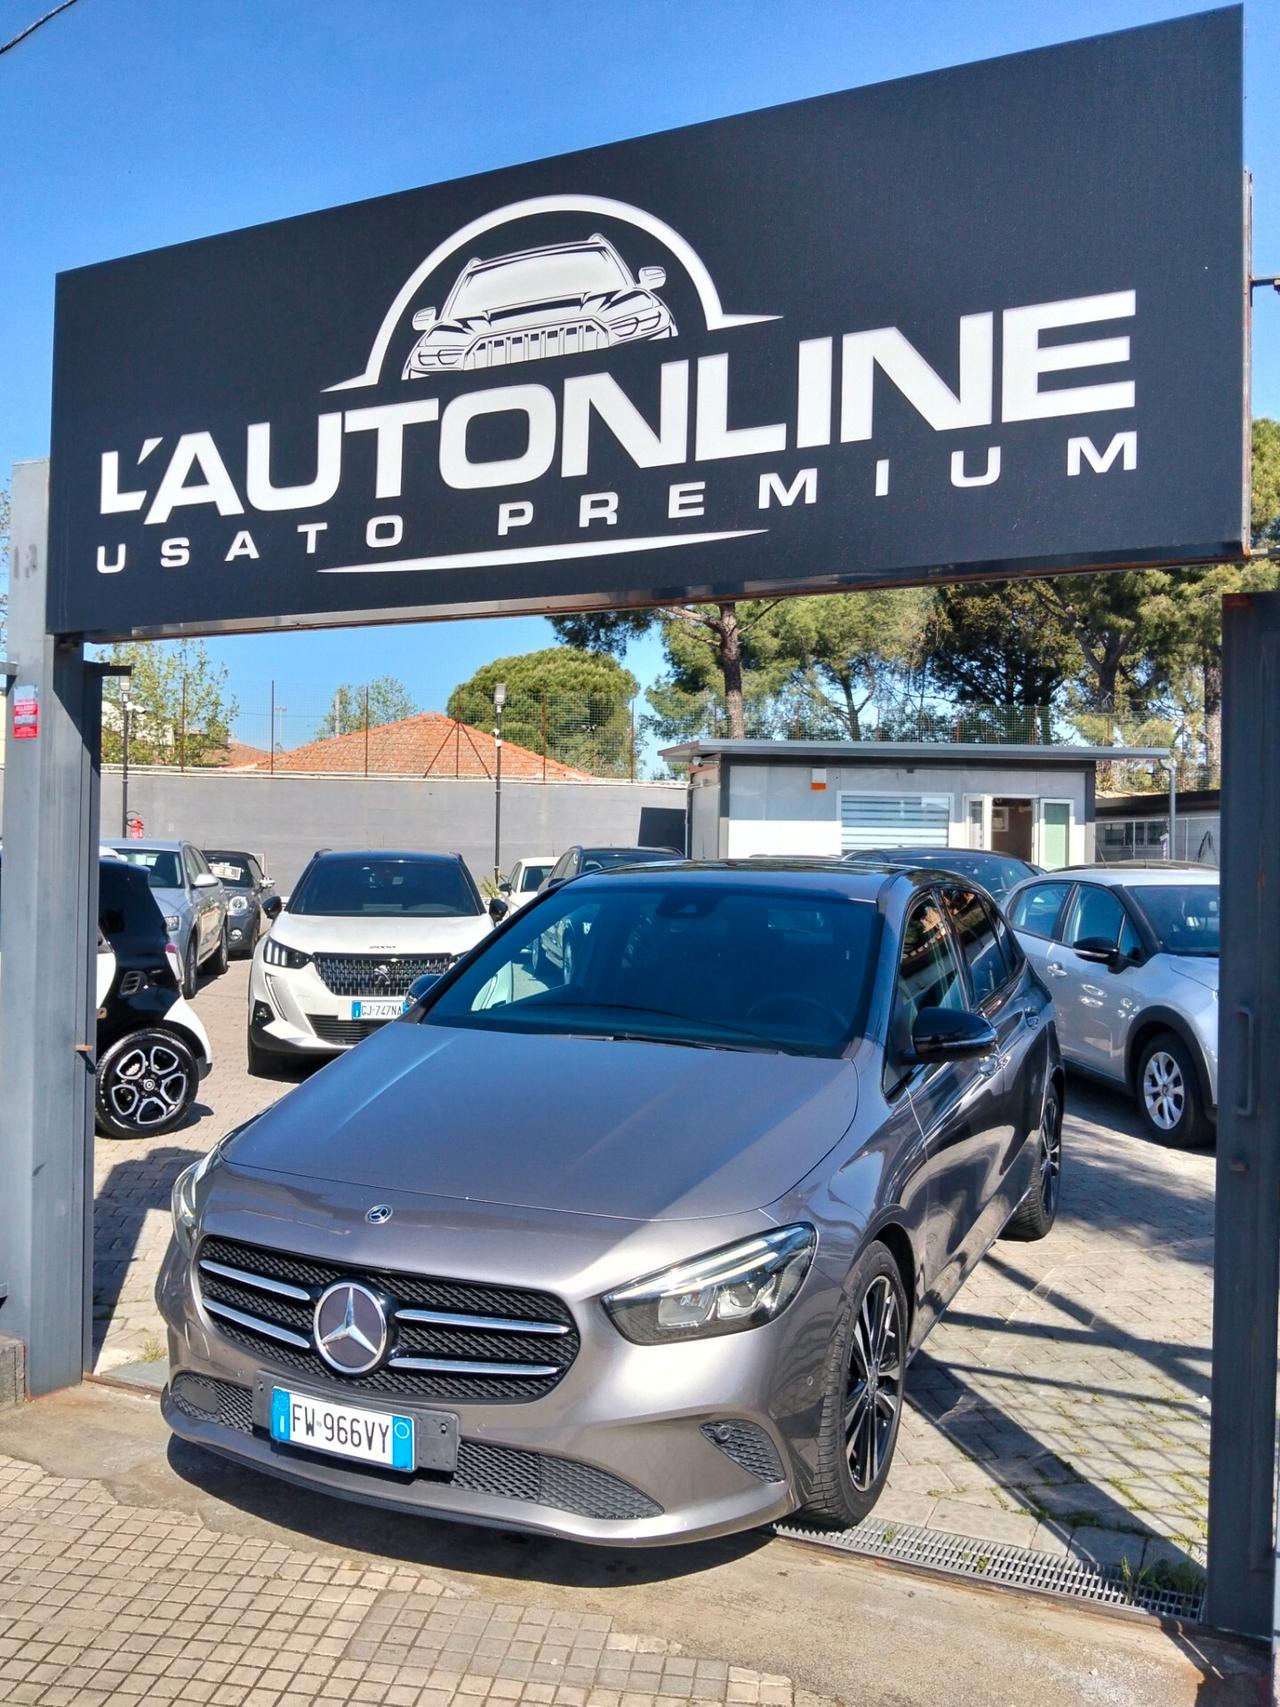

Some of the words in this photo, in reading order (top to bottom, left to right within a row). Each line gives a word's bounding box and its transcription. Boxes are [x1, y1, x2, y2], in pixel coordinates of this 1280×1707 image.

[96, 513, 404, 574] USATO
[497, 430, 1138, 537] PREMIUM
[99, 288, 1138, 526] L'AUTONLINE
